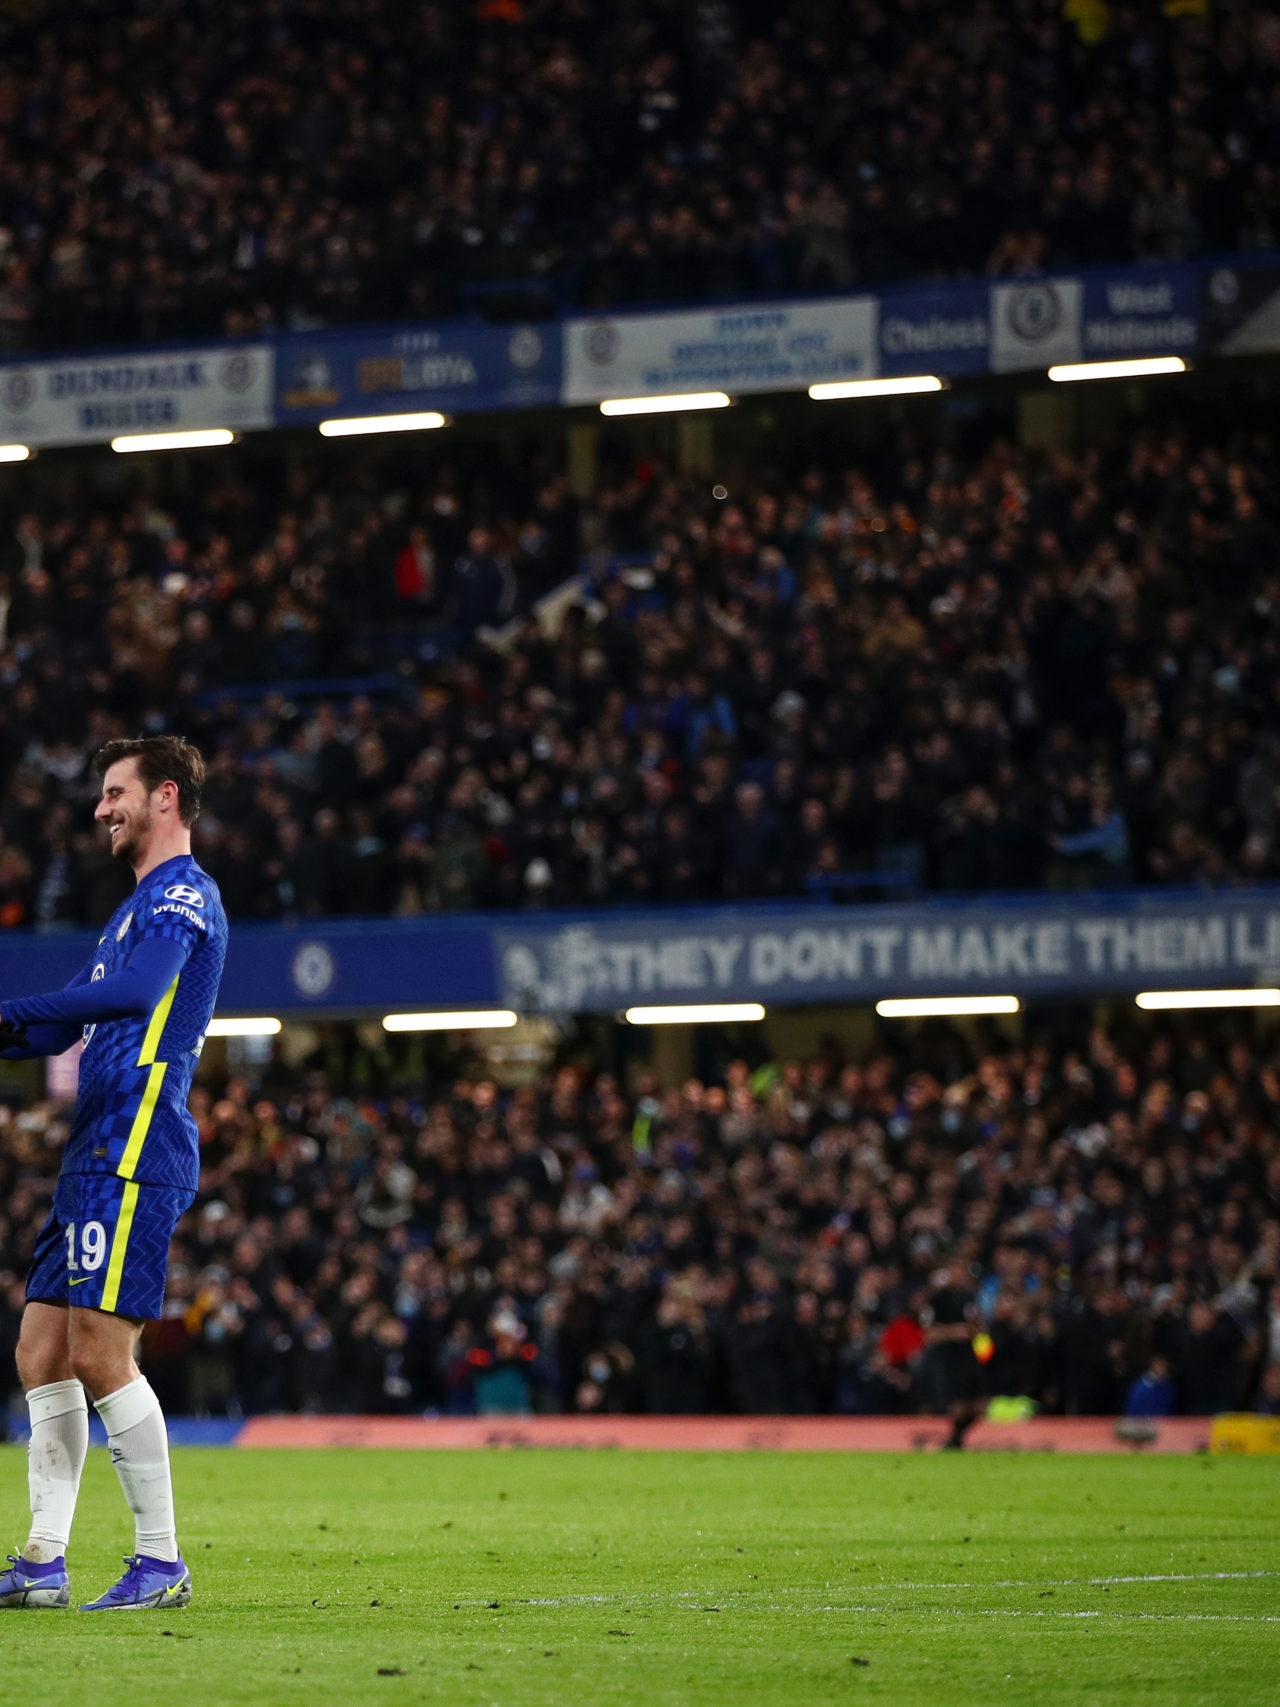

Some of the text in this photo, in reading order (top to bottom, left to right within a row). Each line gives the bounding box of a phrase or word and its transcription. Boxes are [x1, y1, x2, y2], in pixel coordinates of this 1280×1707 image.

[608, 934, 741, 990] THEY
[908, 921, 1067, 978] MAKE
[1077, 914, 1226, 972] THEM
[65, 1220, 107, 1271] 19
